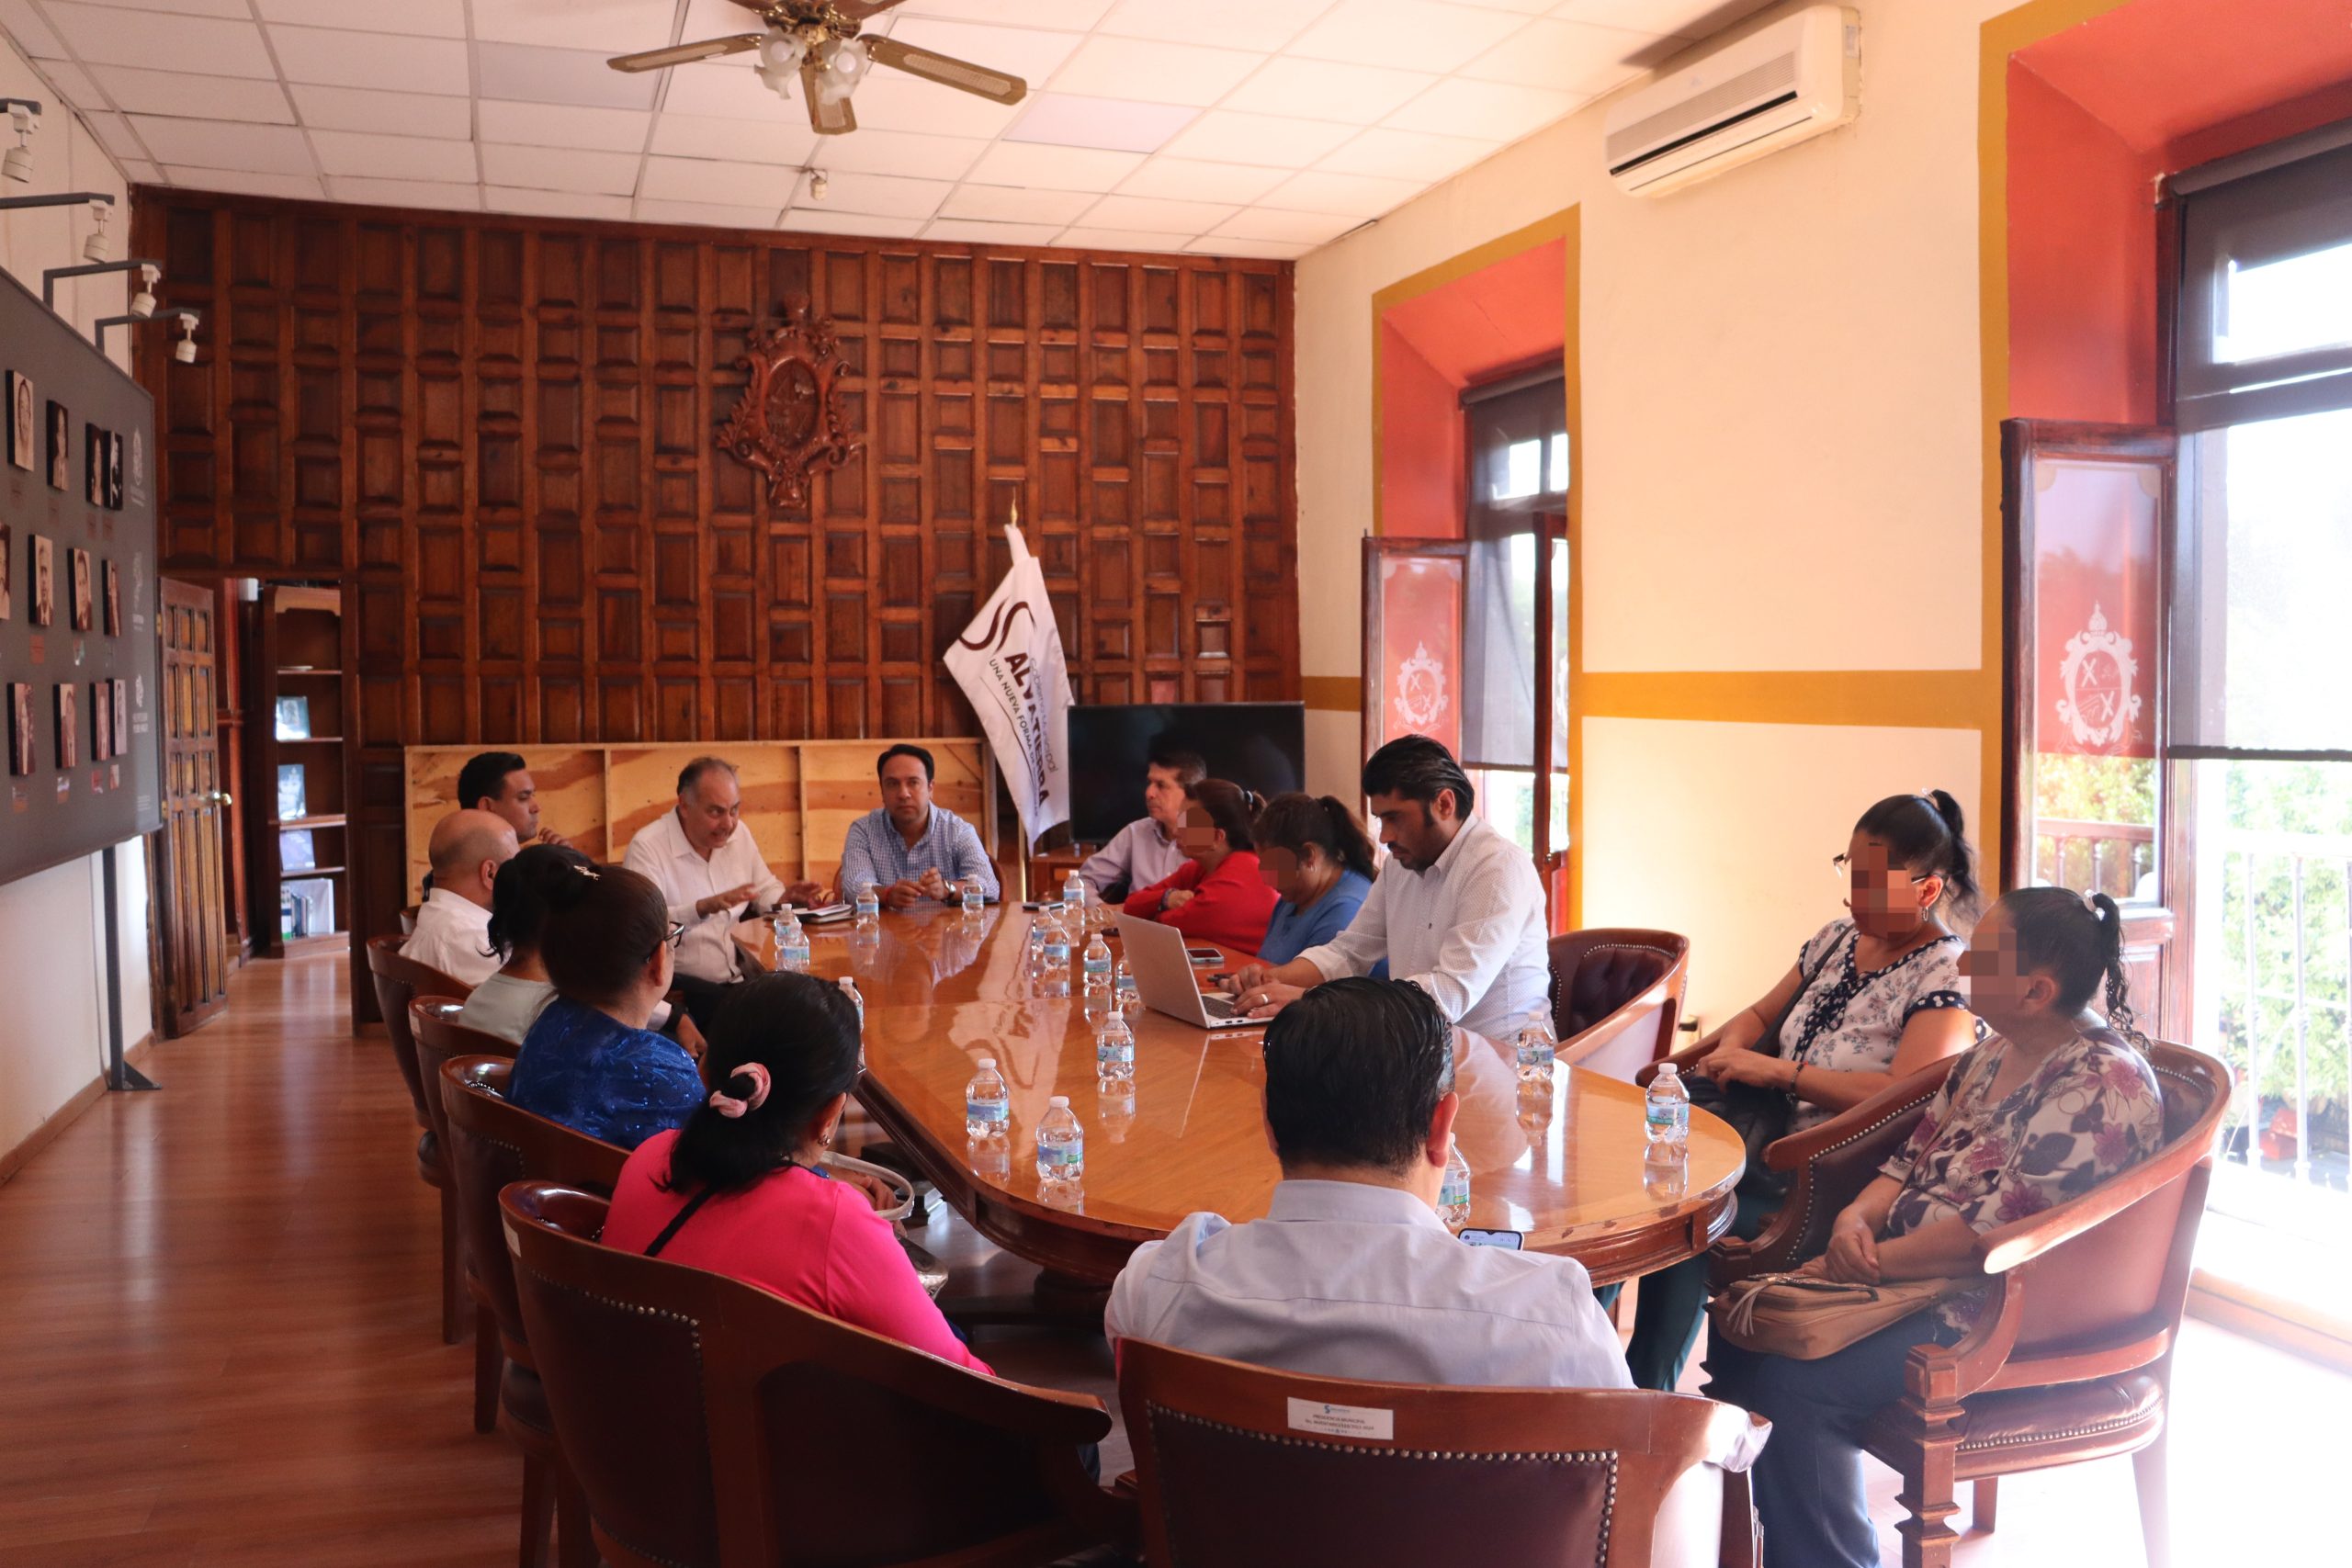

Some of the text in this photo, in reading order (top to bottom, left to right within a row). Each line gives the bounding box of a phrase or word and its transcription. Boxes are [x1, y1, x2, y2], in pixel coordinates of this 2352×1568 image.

[989, 658, 1004, 682] UNA
[1001, 682, 1021, 715] NUEVA
[1017, 715, 1033, 750] FORMA
